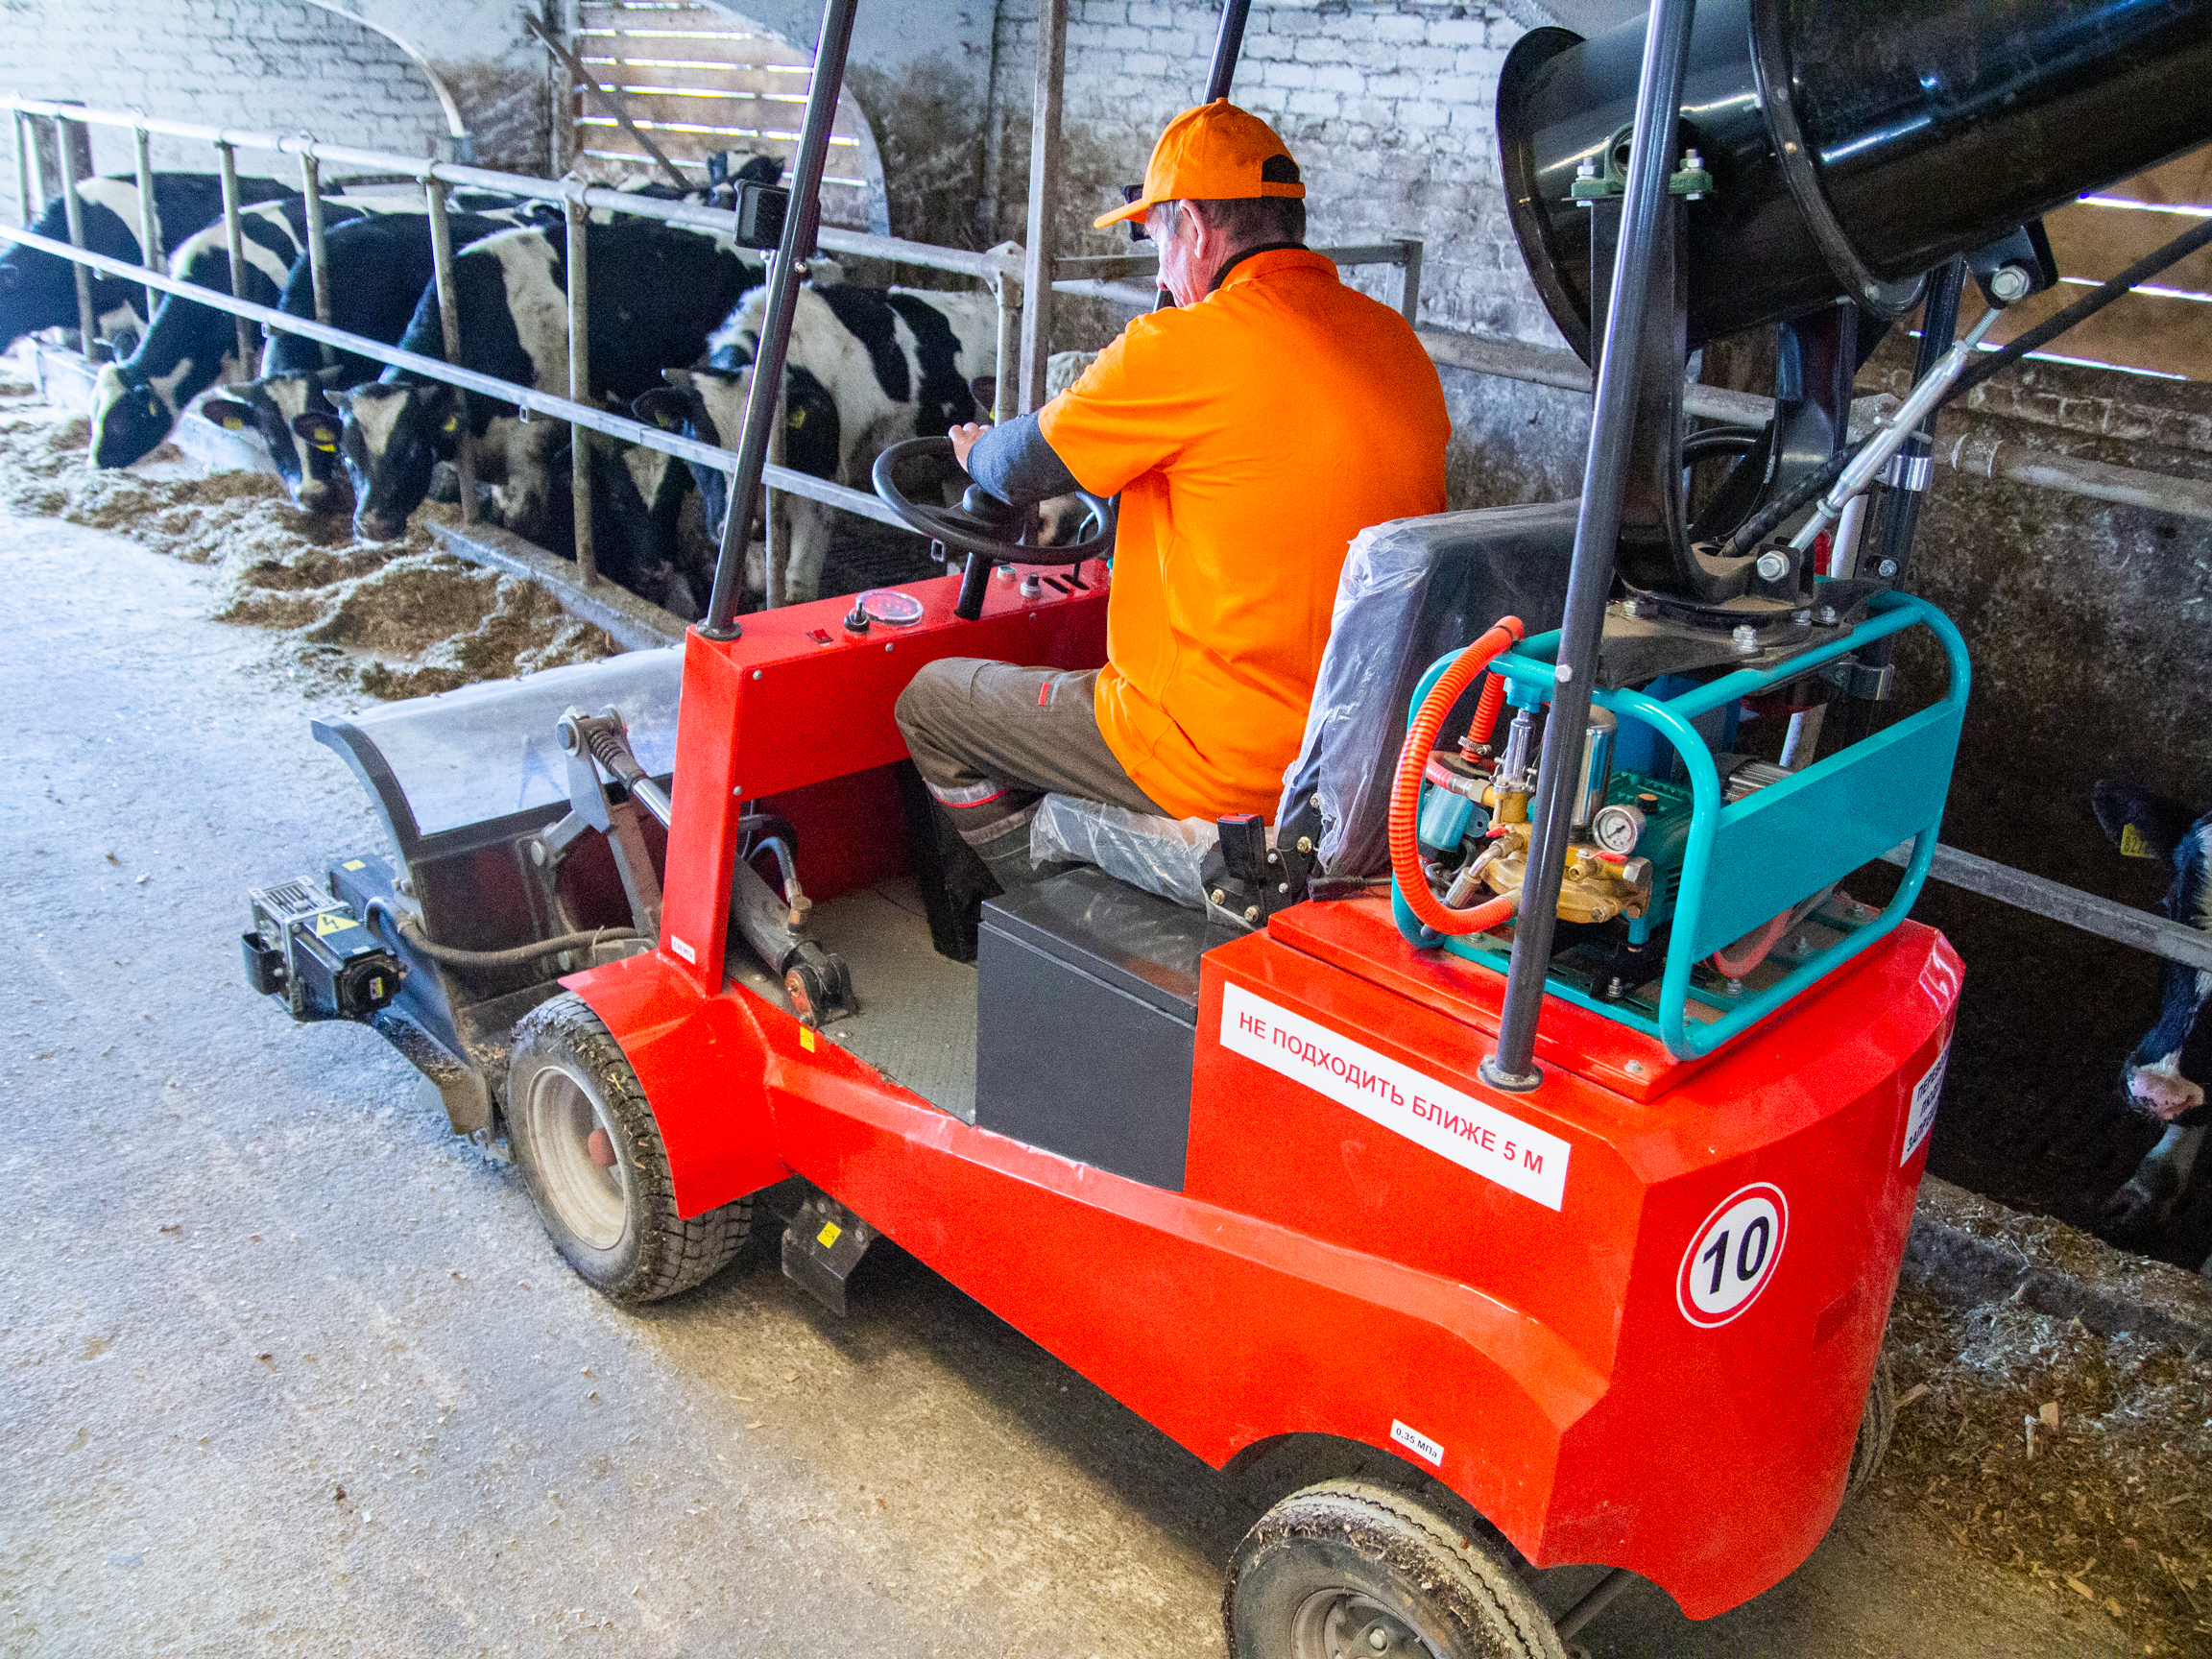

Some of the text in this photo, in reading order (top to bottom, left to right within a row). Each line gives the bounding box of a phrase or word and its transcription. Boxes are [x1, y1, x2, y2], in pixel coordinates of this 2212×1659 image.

[1238, 1011, 1545, 1175] НЕ ПОДХОДИТЬ БЛИЖЕ 5 М
[1702, 1215, 1770, 1295] 10
[1416, 1439, 1438, 1458] МПа
